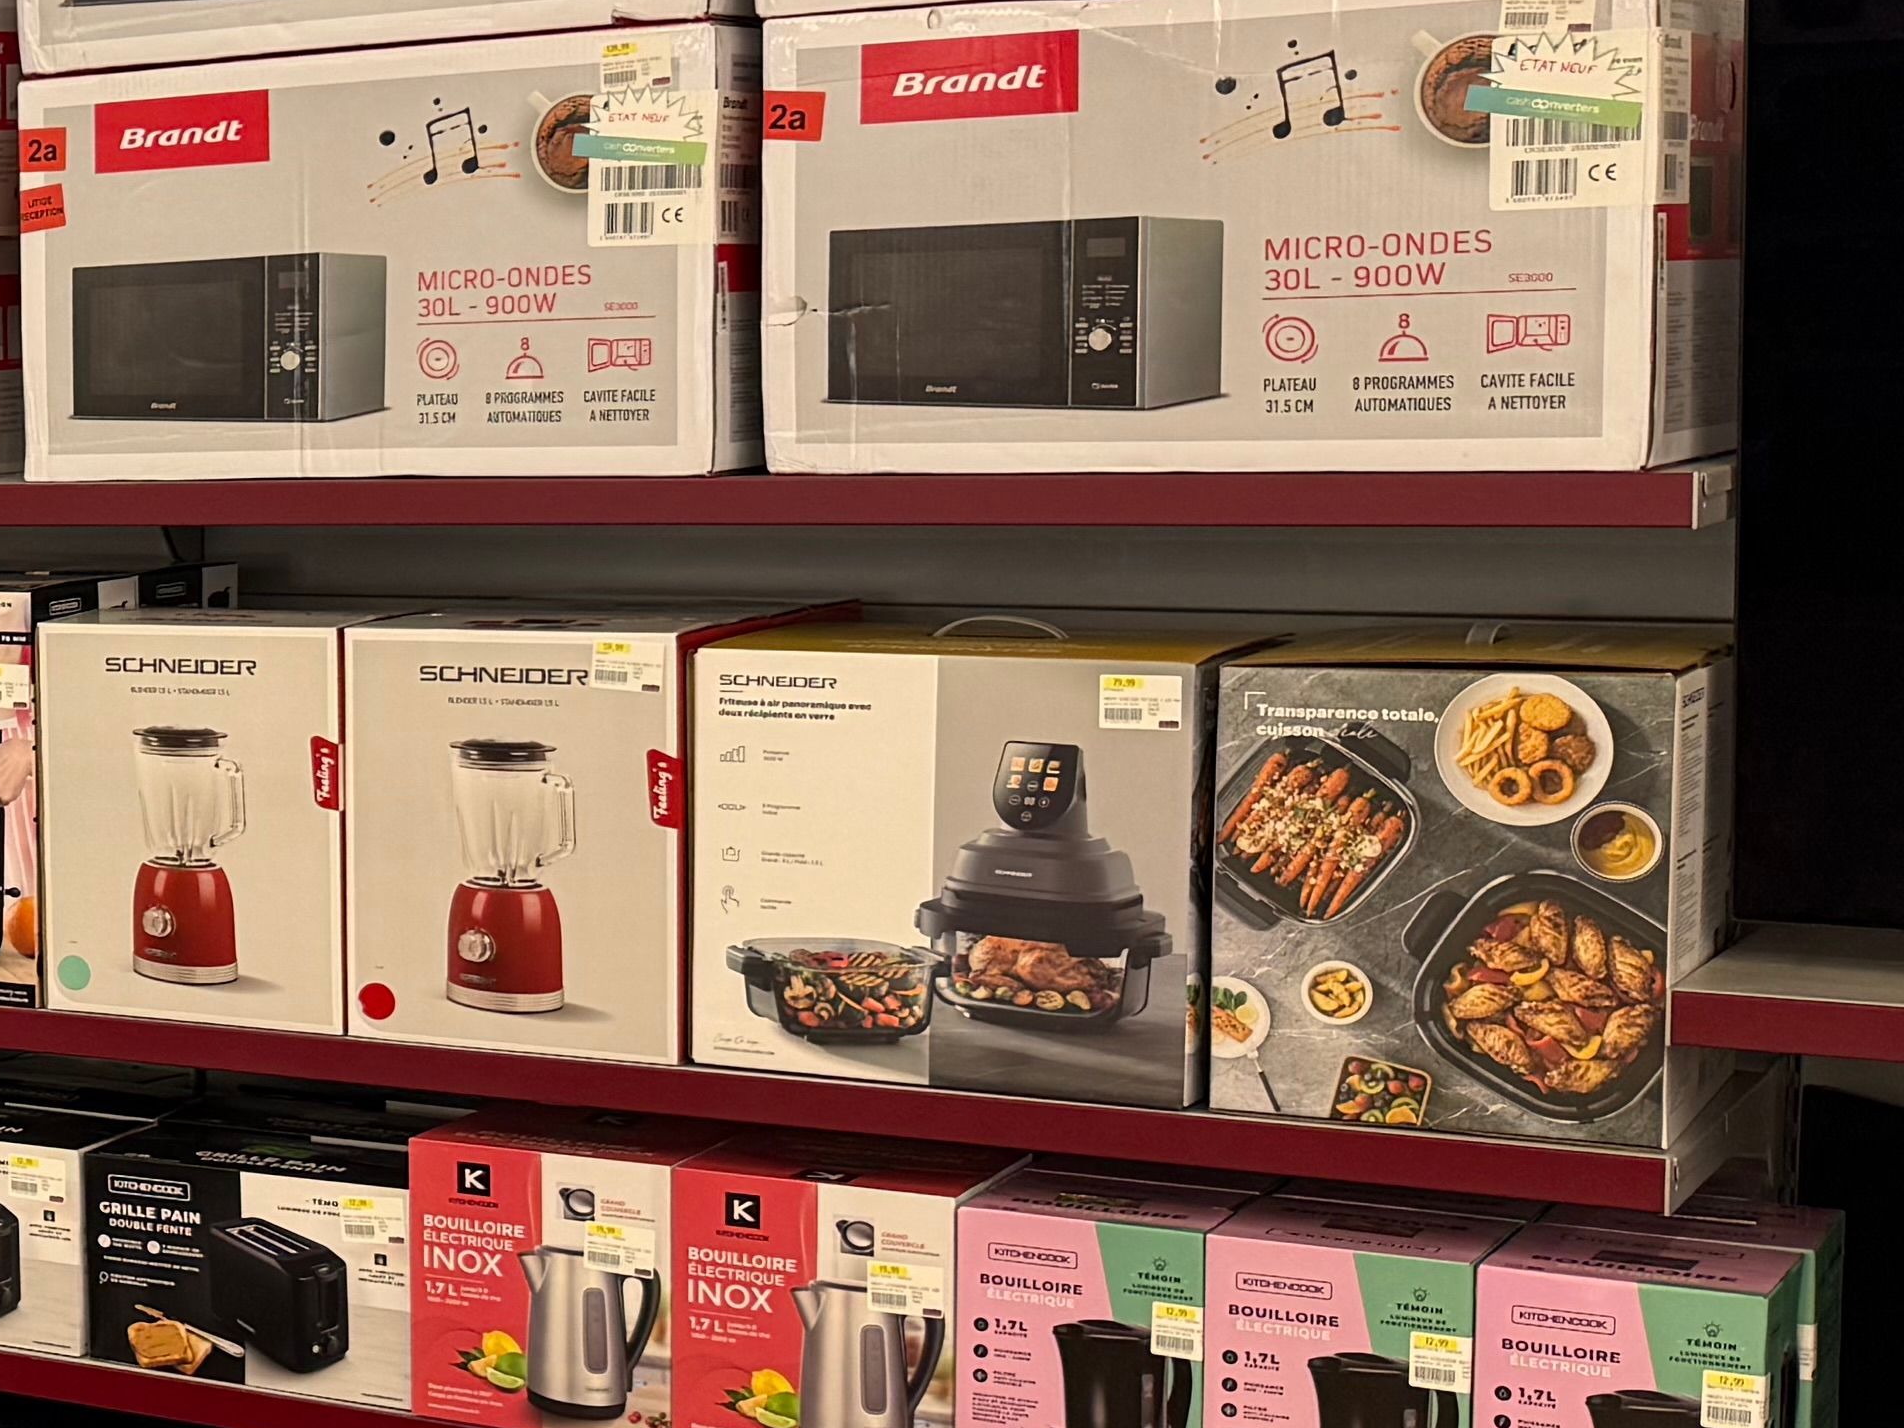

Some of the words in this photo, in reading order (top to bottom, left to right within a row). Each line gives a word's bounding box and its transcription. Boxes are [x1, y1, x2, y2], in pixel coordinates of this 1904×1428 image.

[1519, 60, 1558, 75] ETAT
[1560, 59, 1598, 77] NEUF
[892, 62, 1047, 97] Brandt
[769, 103, 807, 133] 2a
[119, 119, 243, 150] Brandt
[1263, 230, 1493, 260] MICRO-ONDES
[1264, 266, 1322, 291] 30L
[1354, 261, 1447, 288] 900W
[1263, 377, 1317, 393] PLATEAU
[1352, 377, 1361, 391] 8
[1364, 374, 1455, 392] PROGRAMMES
[1480, 373, 1526, 390] CAVITE
[1530, 372, 1576, 389] FACILE
[1265, 399, 1289, 413] 31.5
[1292, 398, 1315, 413] CM
[1354, 395, 1453, 413] AUTOMATIQUES
[1487, 396, 1497, 411] A
[1501, 394, 1567, 411] NETTOYER
[104, 656, 256, 675] SCHNEIDER
[419, 664, 590, 686] SCHNEIDER
[719, 673, 837, 690] SCHNEIDER
[1256, 723, 1324, 737] cuisson
[99, 1201, 153, 1221] GRILLE
[161, 1206, 201, 1225] PAIN
[109, 1218, 151, 1232] DOUBLE
[156, 1222, 192, 1236] FENTE
[423, 1214, 525, 1237] BOUILLOIRE
[424, 1229, 514, 1251] ÉLECTRIQUE
[423, 1249, 503, 1277] INOX
[687, 1247, 797, 1273] BOUILLOIRE
[687, 1262, 785, 1288] ÉLECTRIQUE
[687, 1280, 772, 1313] INOX
[1228, 1304, 1340, 1329] BOUILLOIRE
[1235, 1317, 1331, 1341] ÉLECTRIQUE
[1502, 1339, 1621, 1365] BOUILLOIRE
[1686, 1336, 1737, 1352] TÉMOIN
[1510, 1354, 1611, 1378] ÉLECTRIQUE
[1517, 1386, 1556, 1403] 1,7L
